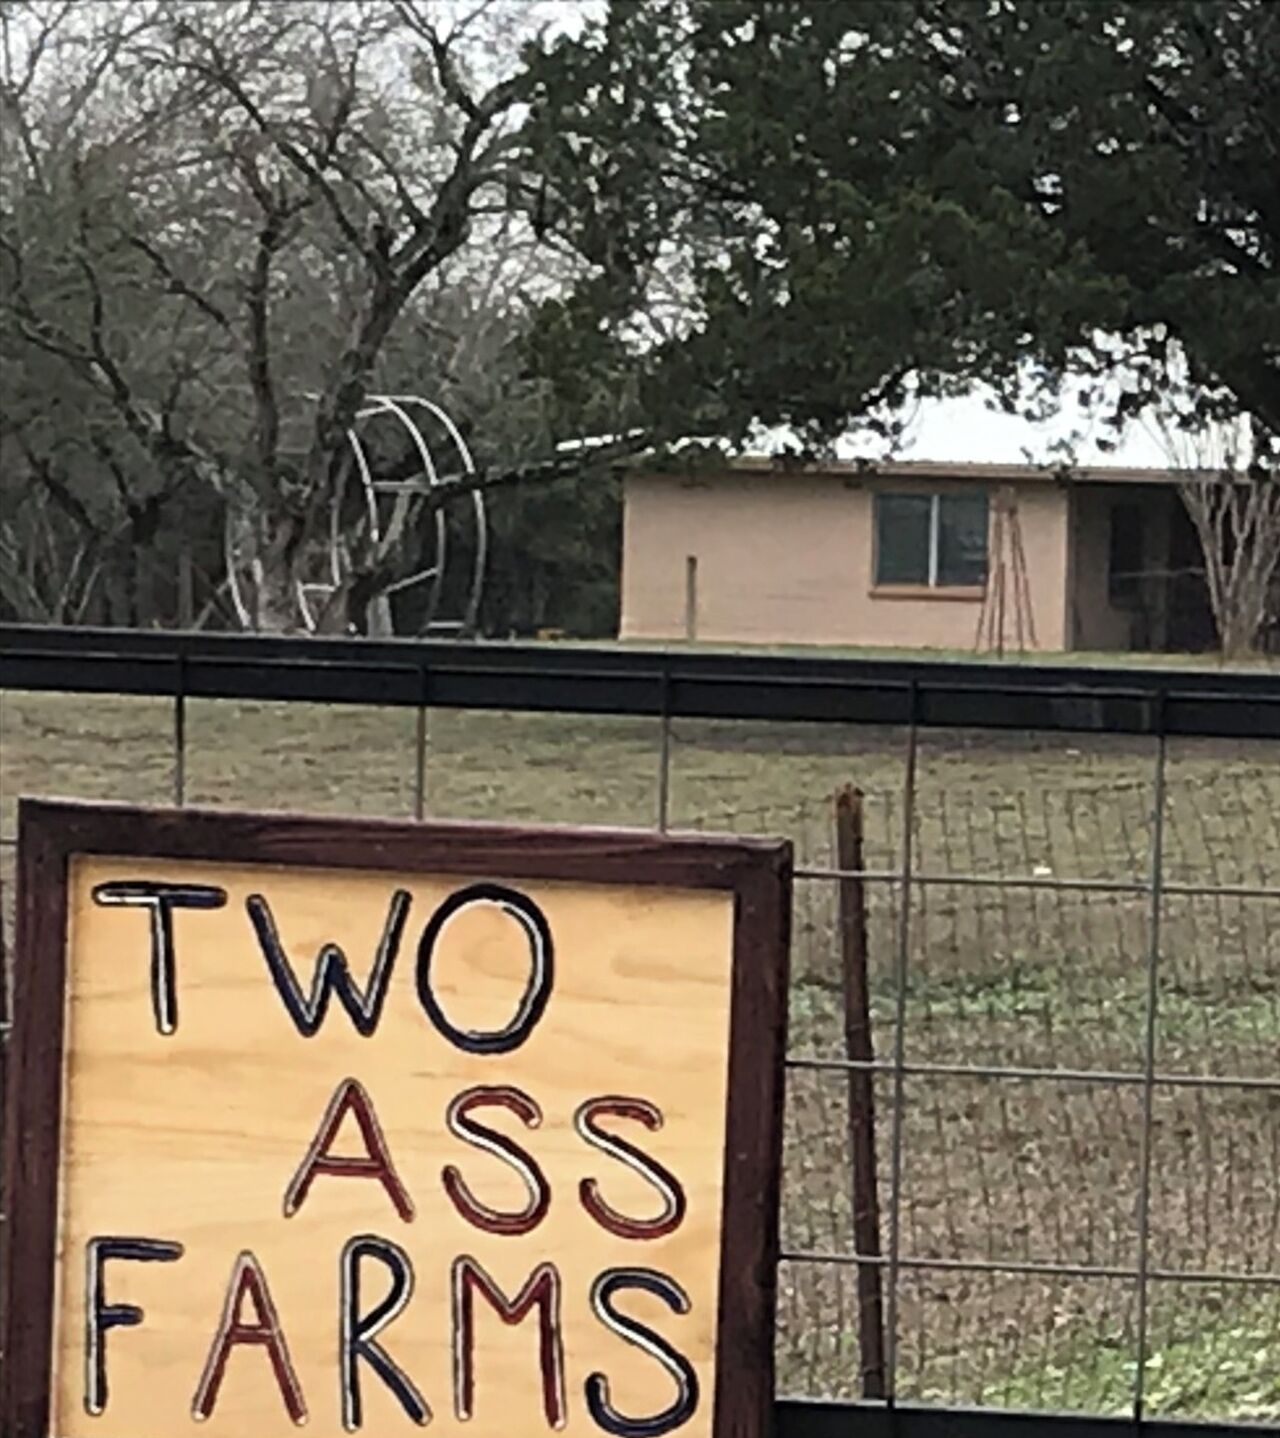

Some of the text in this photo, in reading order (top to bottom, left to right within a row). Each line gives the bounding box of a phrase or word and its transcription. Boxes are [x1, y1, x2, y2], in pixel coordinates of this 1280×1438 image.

[92, 880, 554, 1054] TWO
[283, 1078, 687, 1239] ASS
[85, 1234, 699, 1438] FARMS
